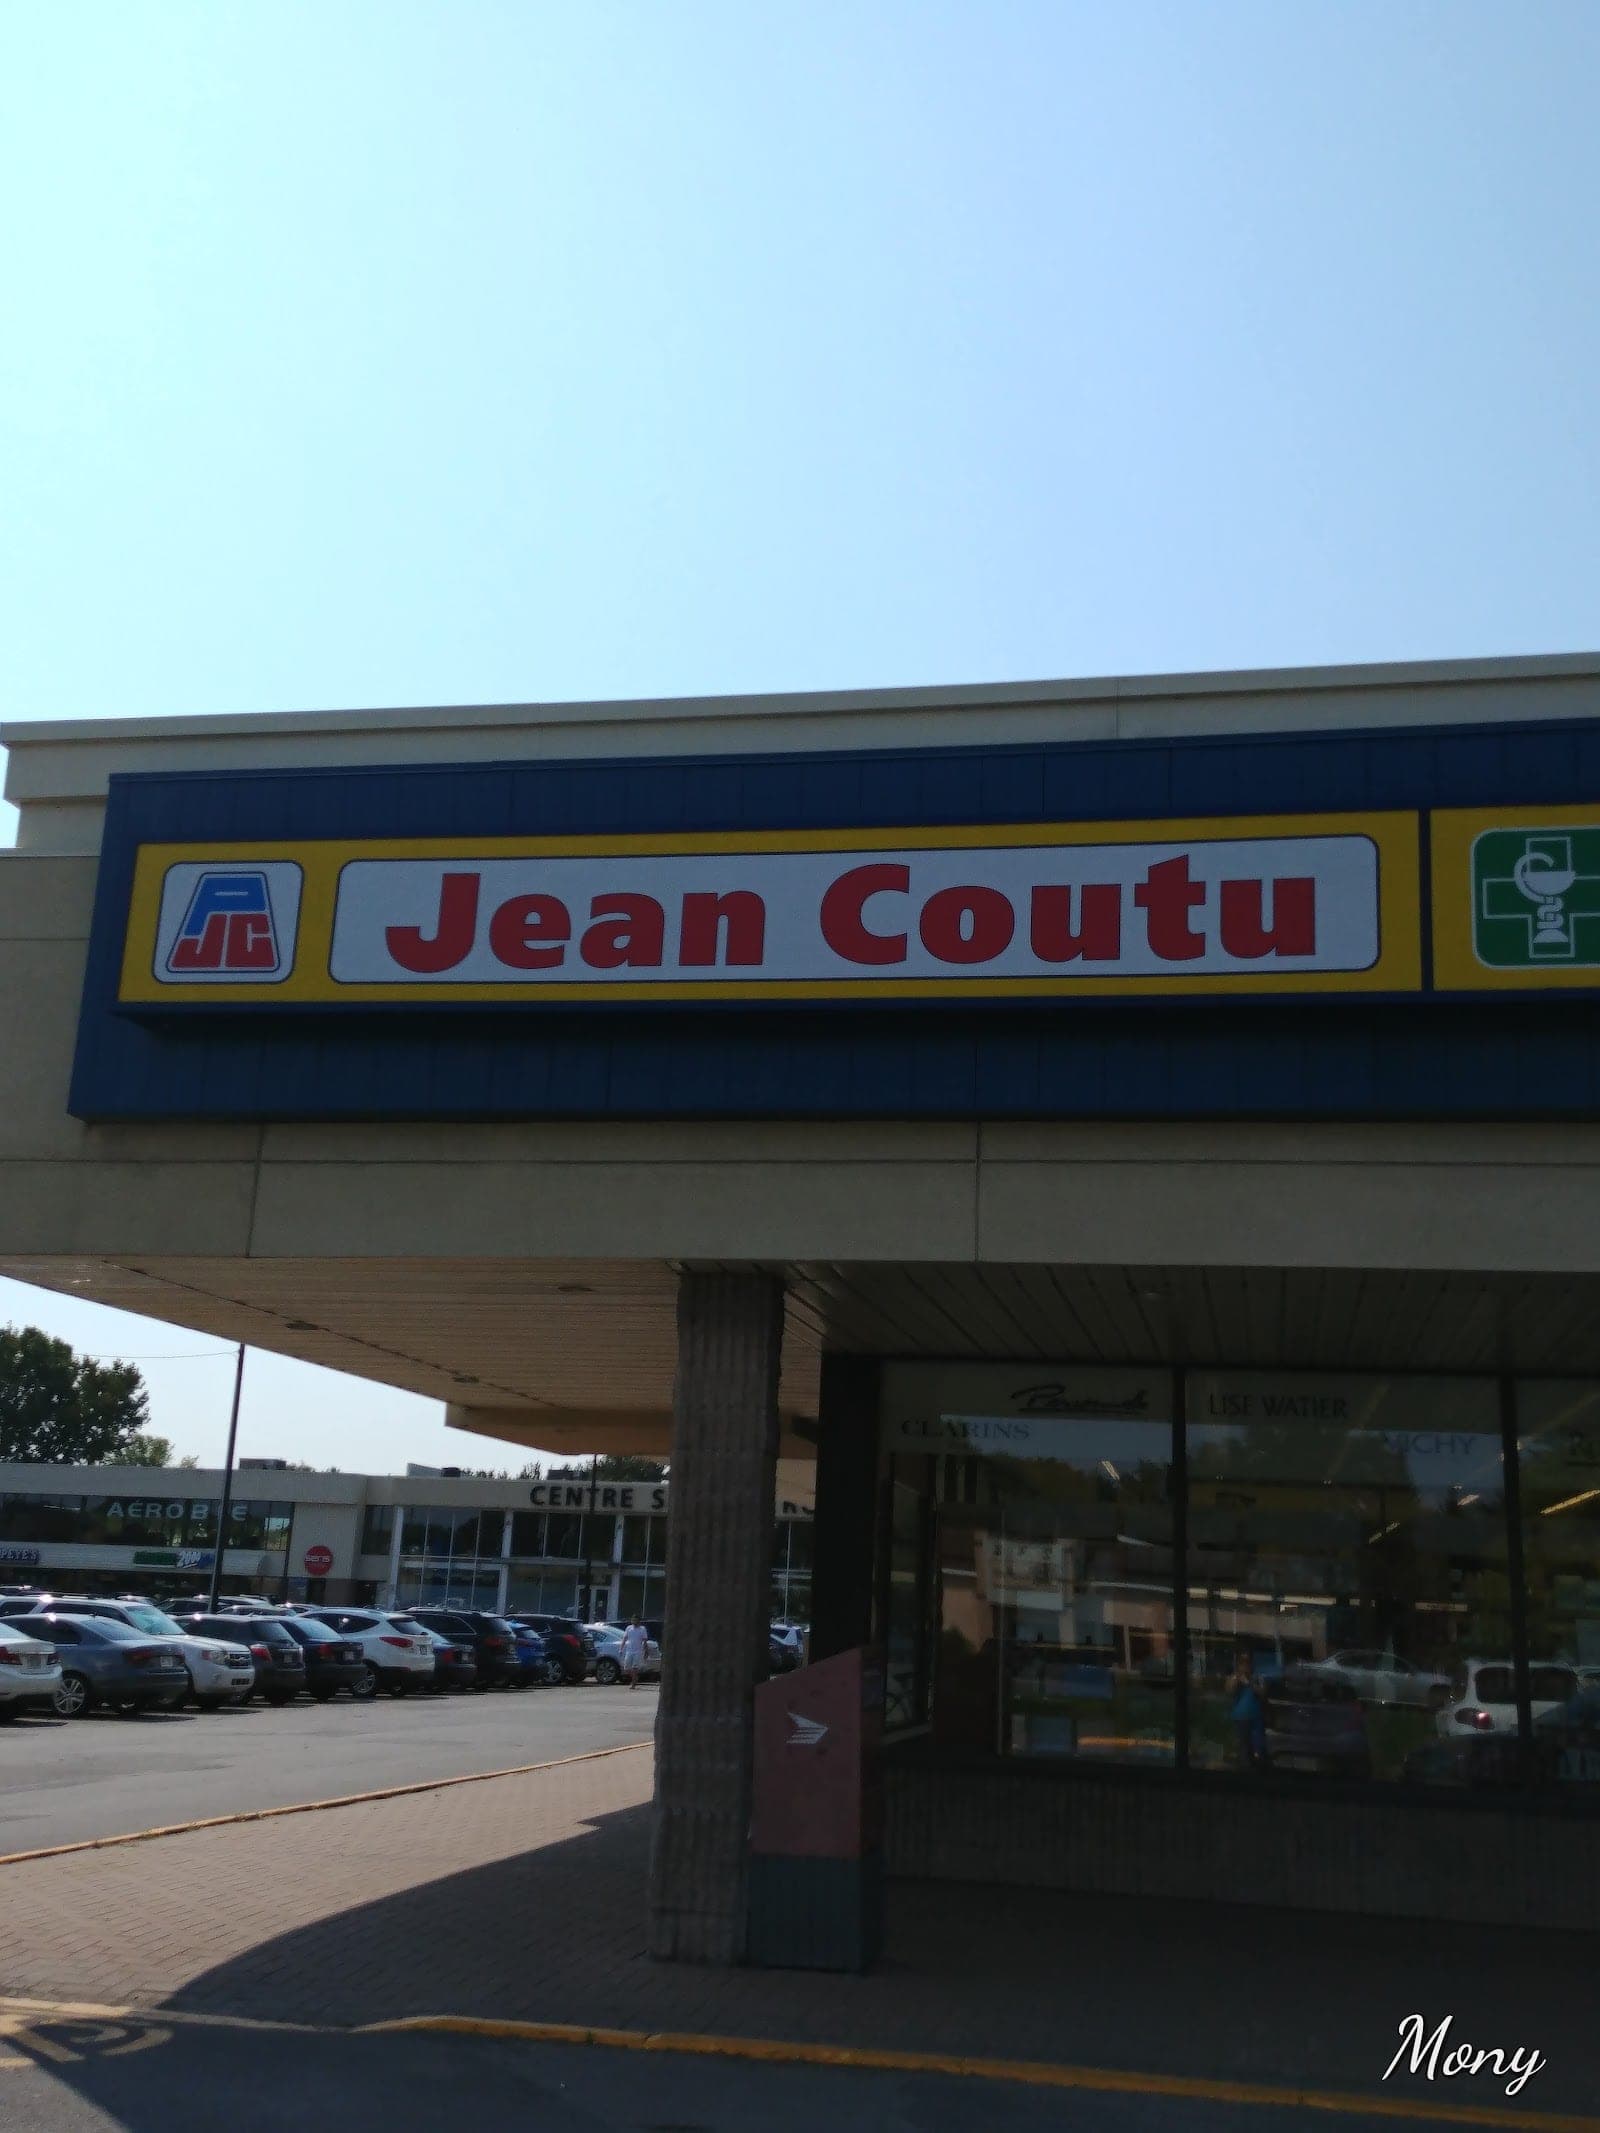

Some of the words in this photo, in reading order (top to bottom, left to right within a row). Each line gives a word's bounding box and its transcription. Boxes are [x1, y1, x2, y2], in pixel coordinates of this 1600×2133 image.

[385, 872, 765, 974] Jean
[819, 853, 1317, 966] Coutu
[1262, 1396, 1348, 1419] WATIER
[901, 1419, 1030, 1440] CLARINS
[529, 1485, 633, 1509] CENTRE
